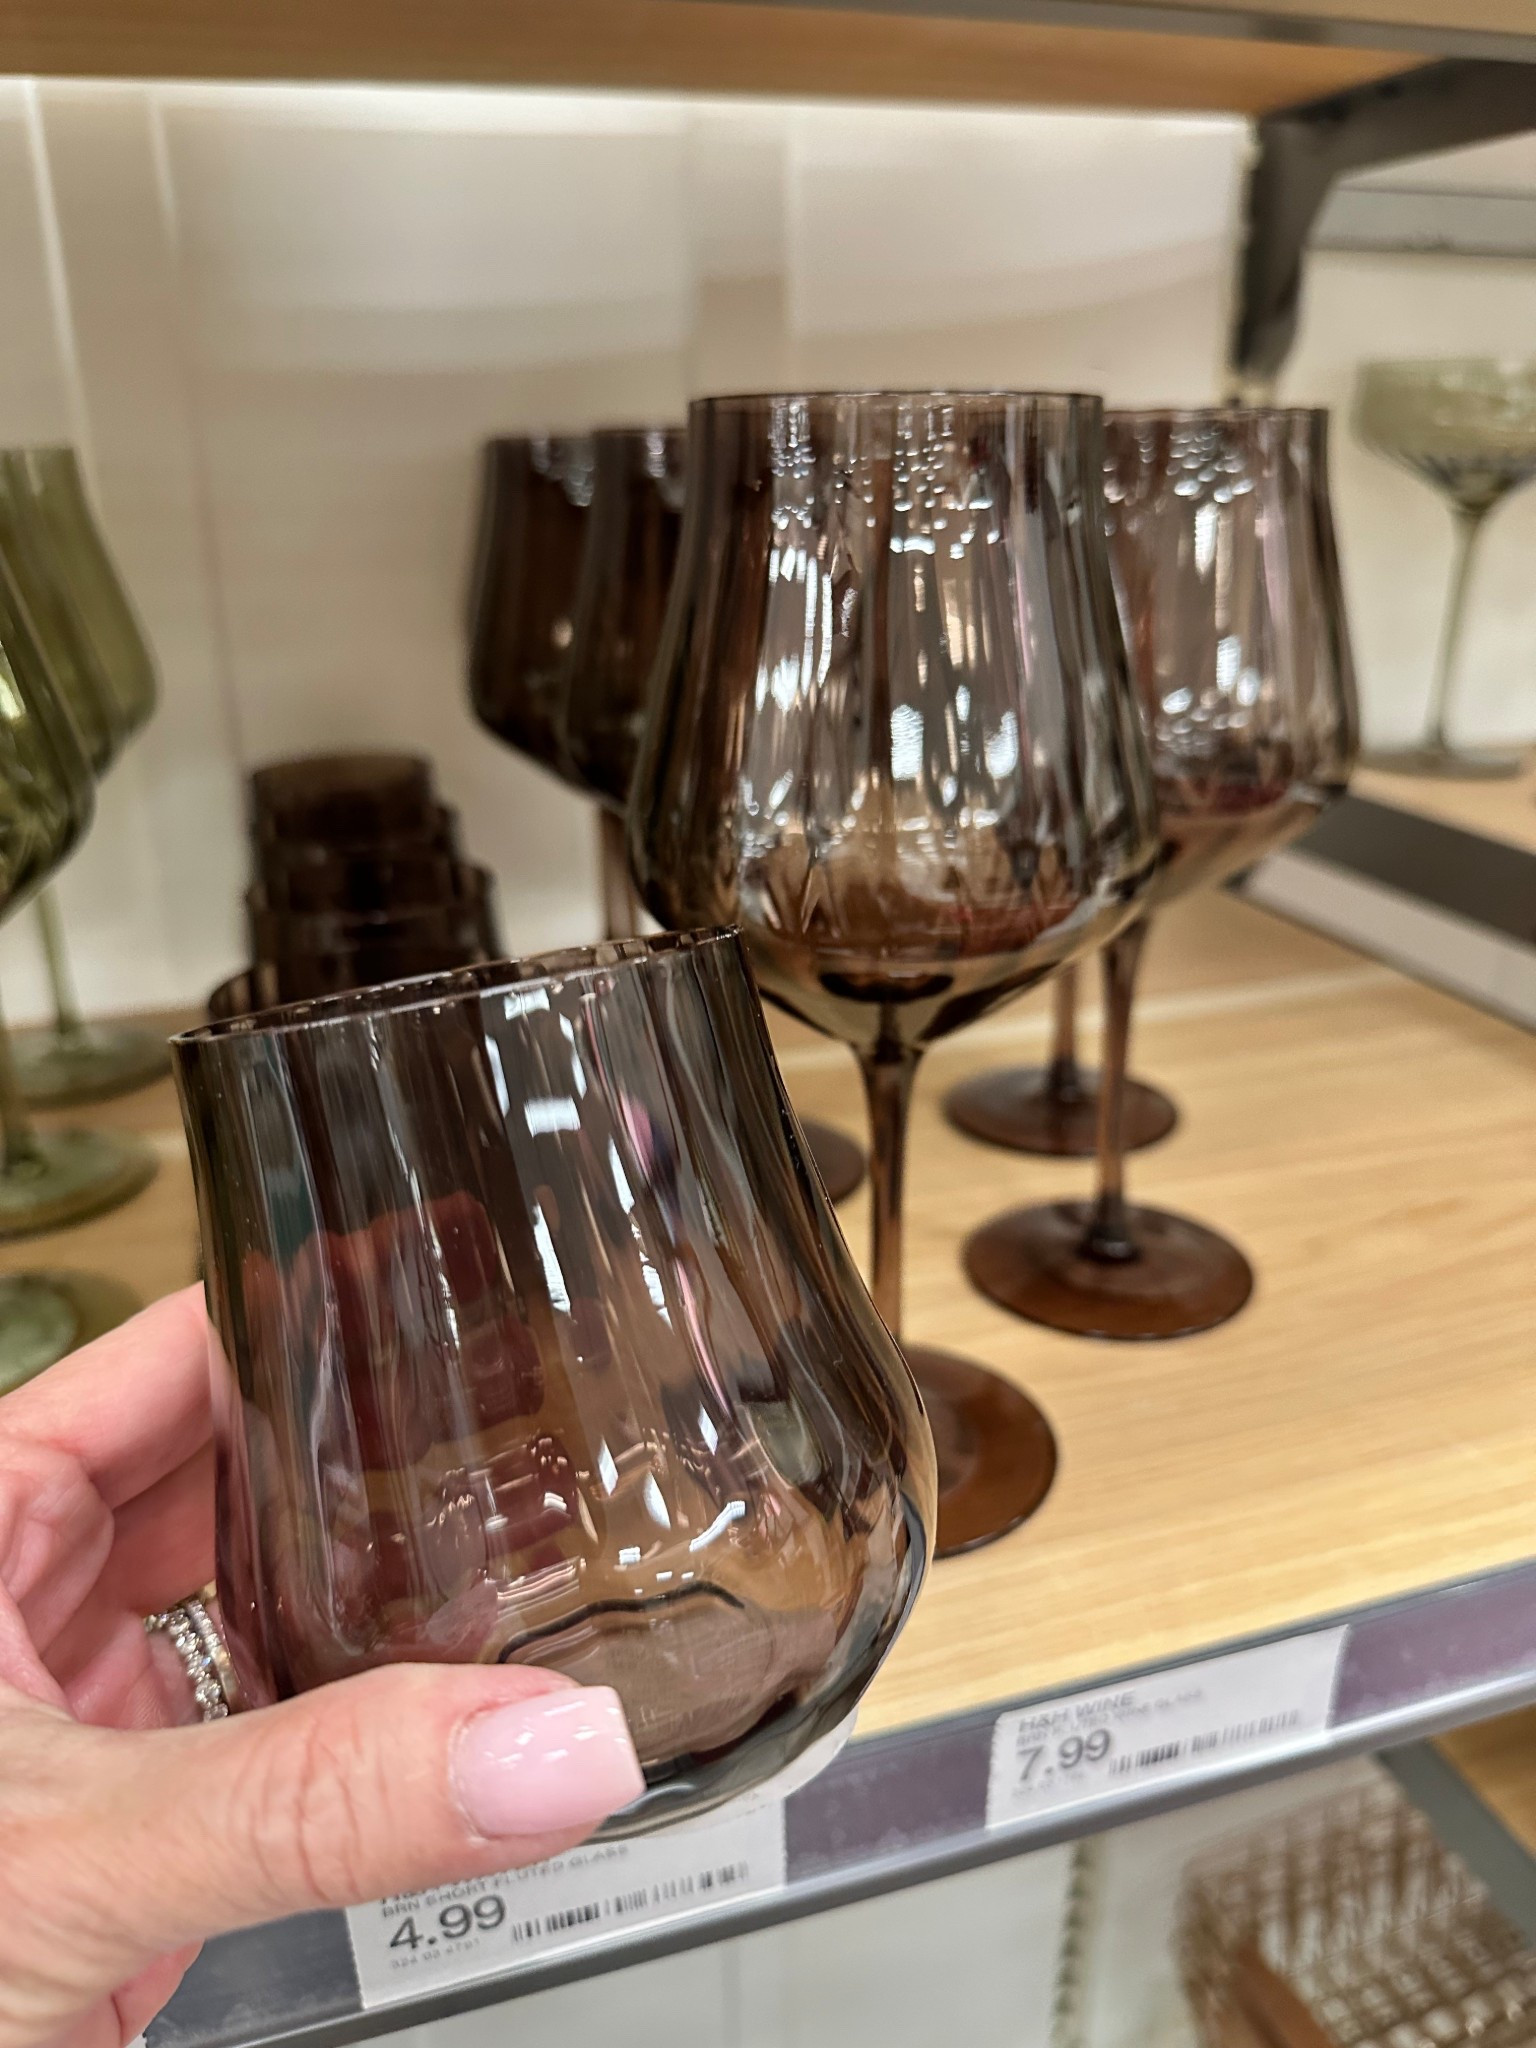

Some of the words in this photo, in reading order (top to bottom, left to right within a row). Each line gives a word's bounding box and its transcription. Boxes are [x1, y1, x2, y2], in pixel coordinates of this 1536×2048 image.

[1075, 1691, 1135, 1719] WINE
[1017, 1728, 1111, 1781] 7.99
[389, 1893, 507, 1950] 4.99
